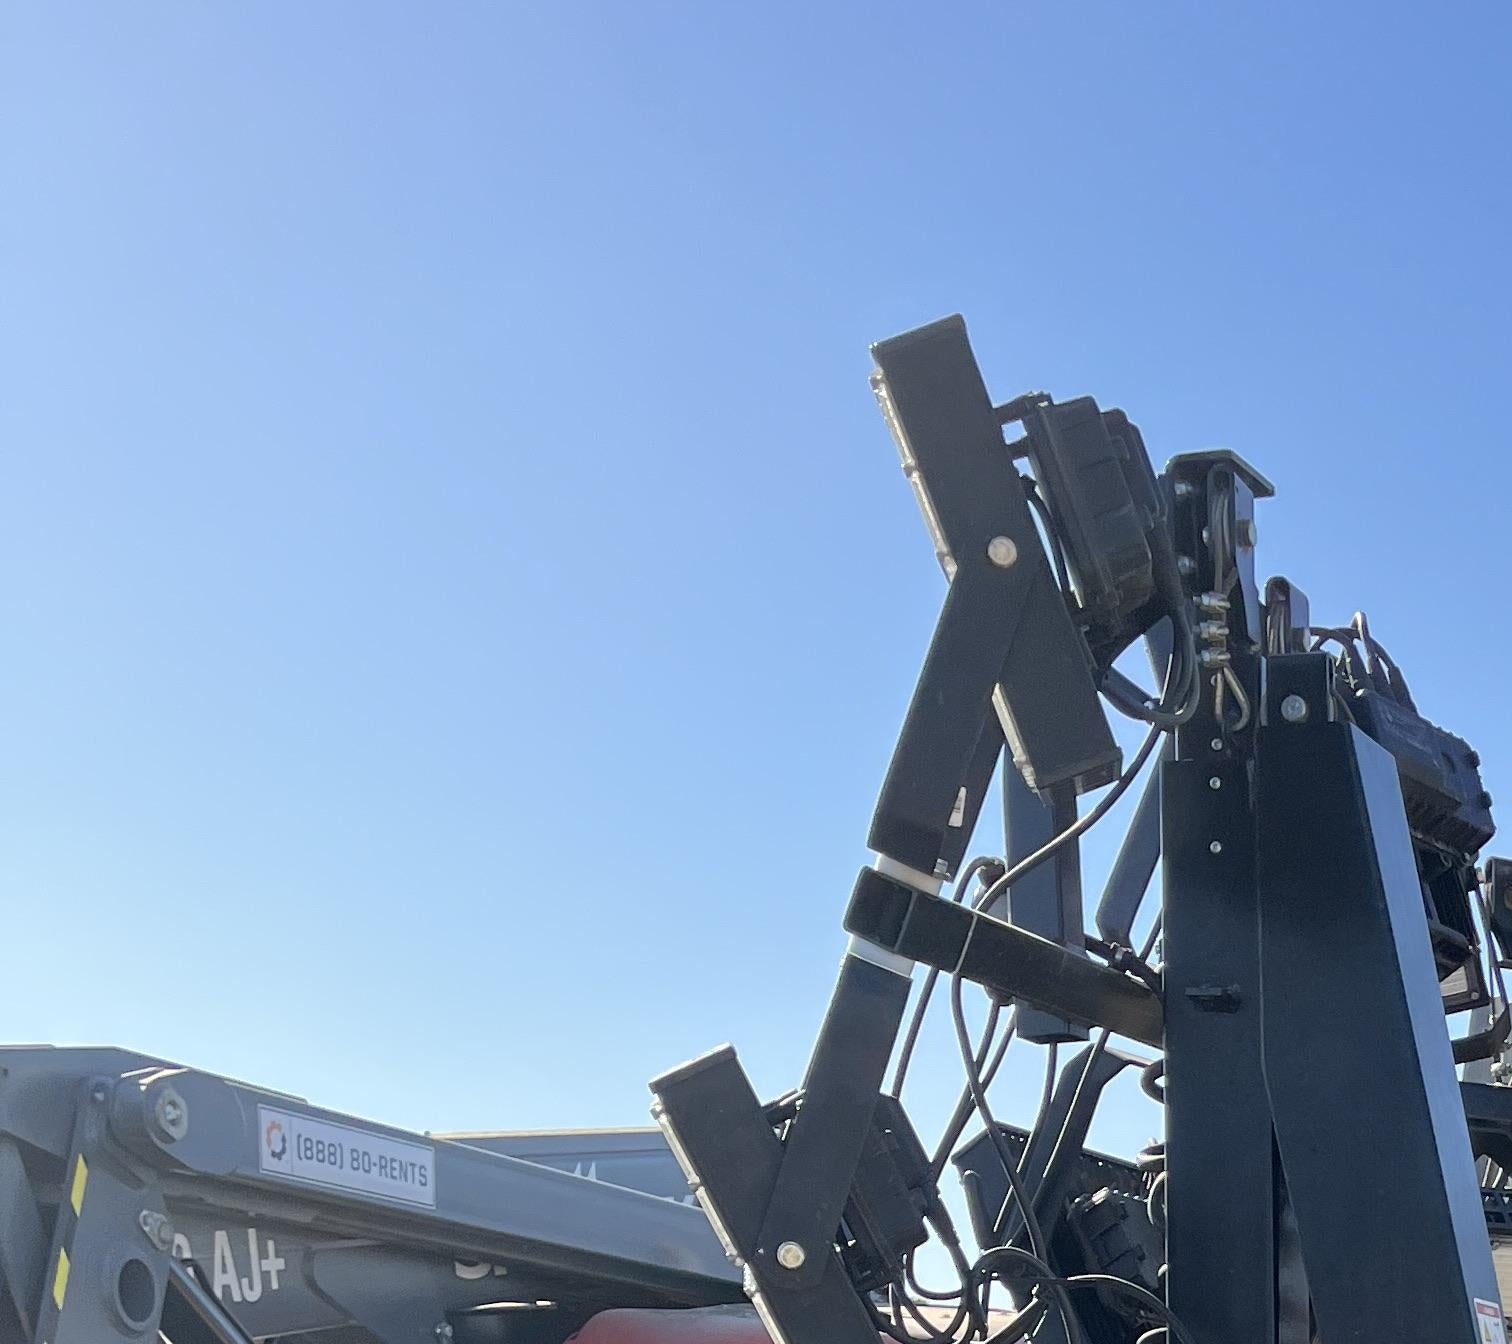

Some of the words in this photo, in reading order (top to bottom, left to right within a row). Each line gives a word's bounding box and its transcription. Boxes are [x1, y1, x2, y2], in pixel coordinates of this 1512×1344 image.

[296, 1133, 344, 1170] (888)
[350, 1148, 428, 1187] 80-RENTS
[213, 1228, 286, 1303] AJ+
